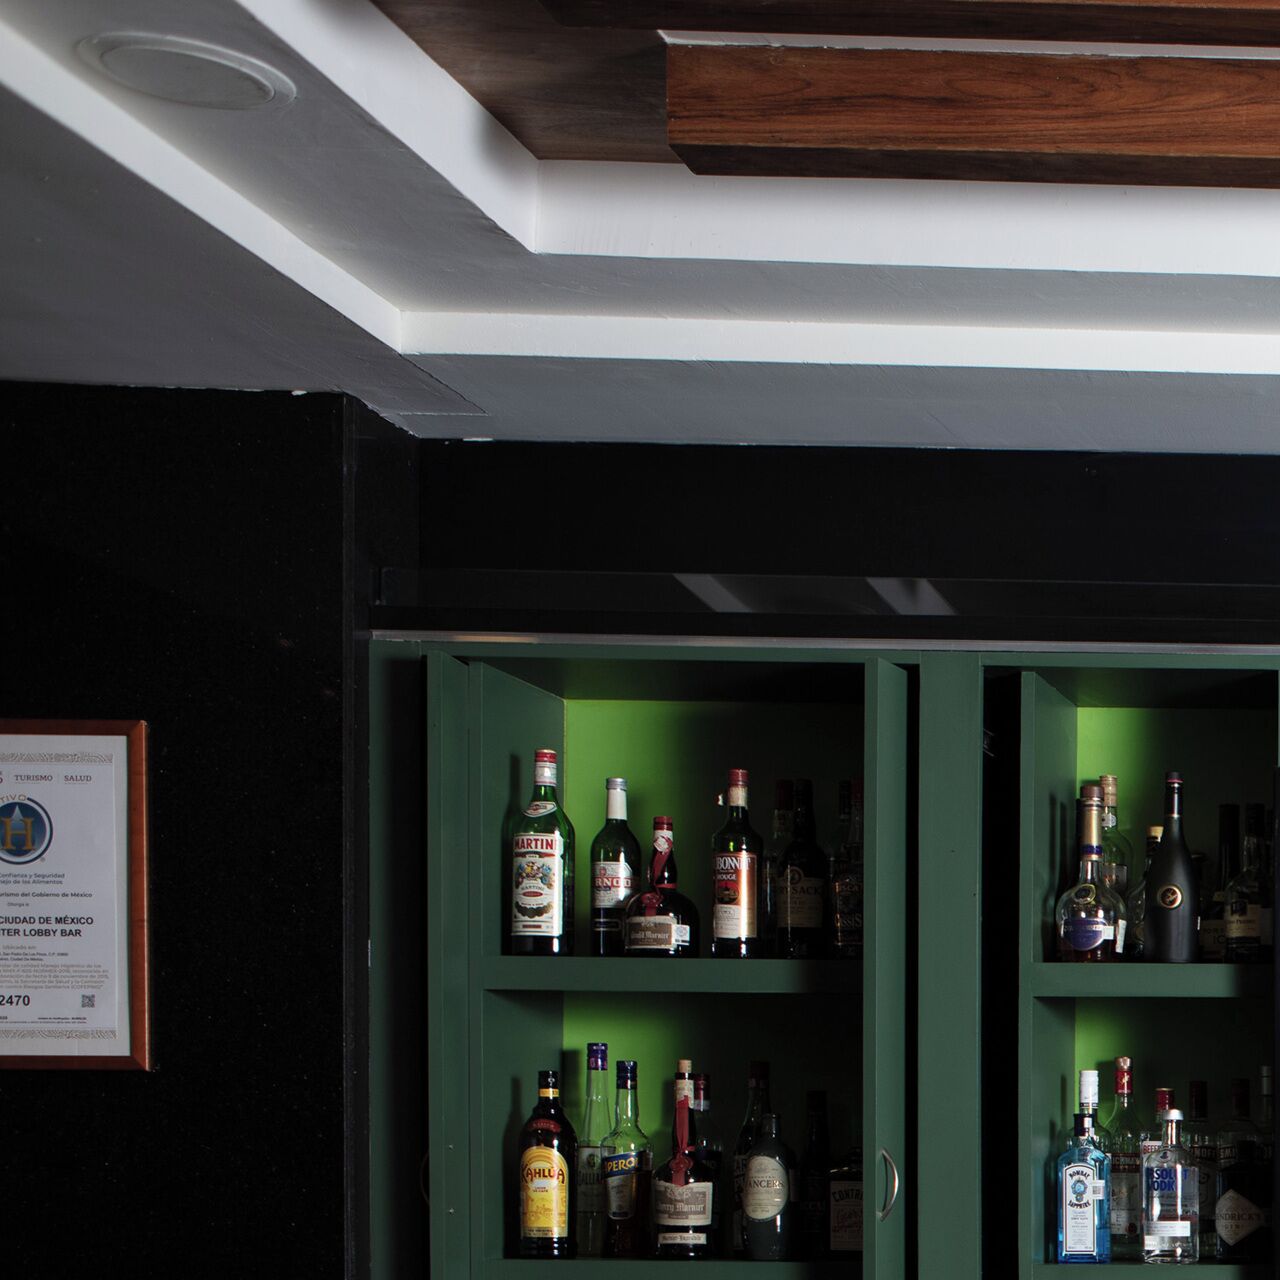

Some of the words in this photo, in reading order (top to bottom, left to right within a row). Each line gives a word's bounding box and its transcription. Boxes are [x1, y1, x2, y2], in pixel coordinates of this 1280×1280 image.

[15, 774, 53, 782] TURISMO
[64, 774, 92, 782] SALUD
[38, 916, 52, 926] DE
[54, 914, 94, 926] MÉXICO
[23, 928, 58, 938] LOBBY
[60, 928, 82, 938] BAR
[0, 994, 31, 1007] 2470
[1069, 1170, 1091, 1179] BOMBAY
[1067, 1201, 1092, 1210] SAPPHIRE
